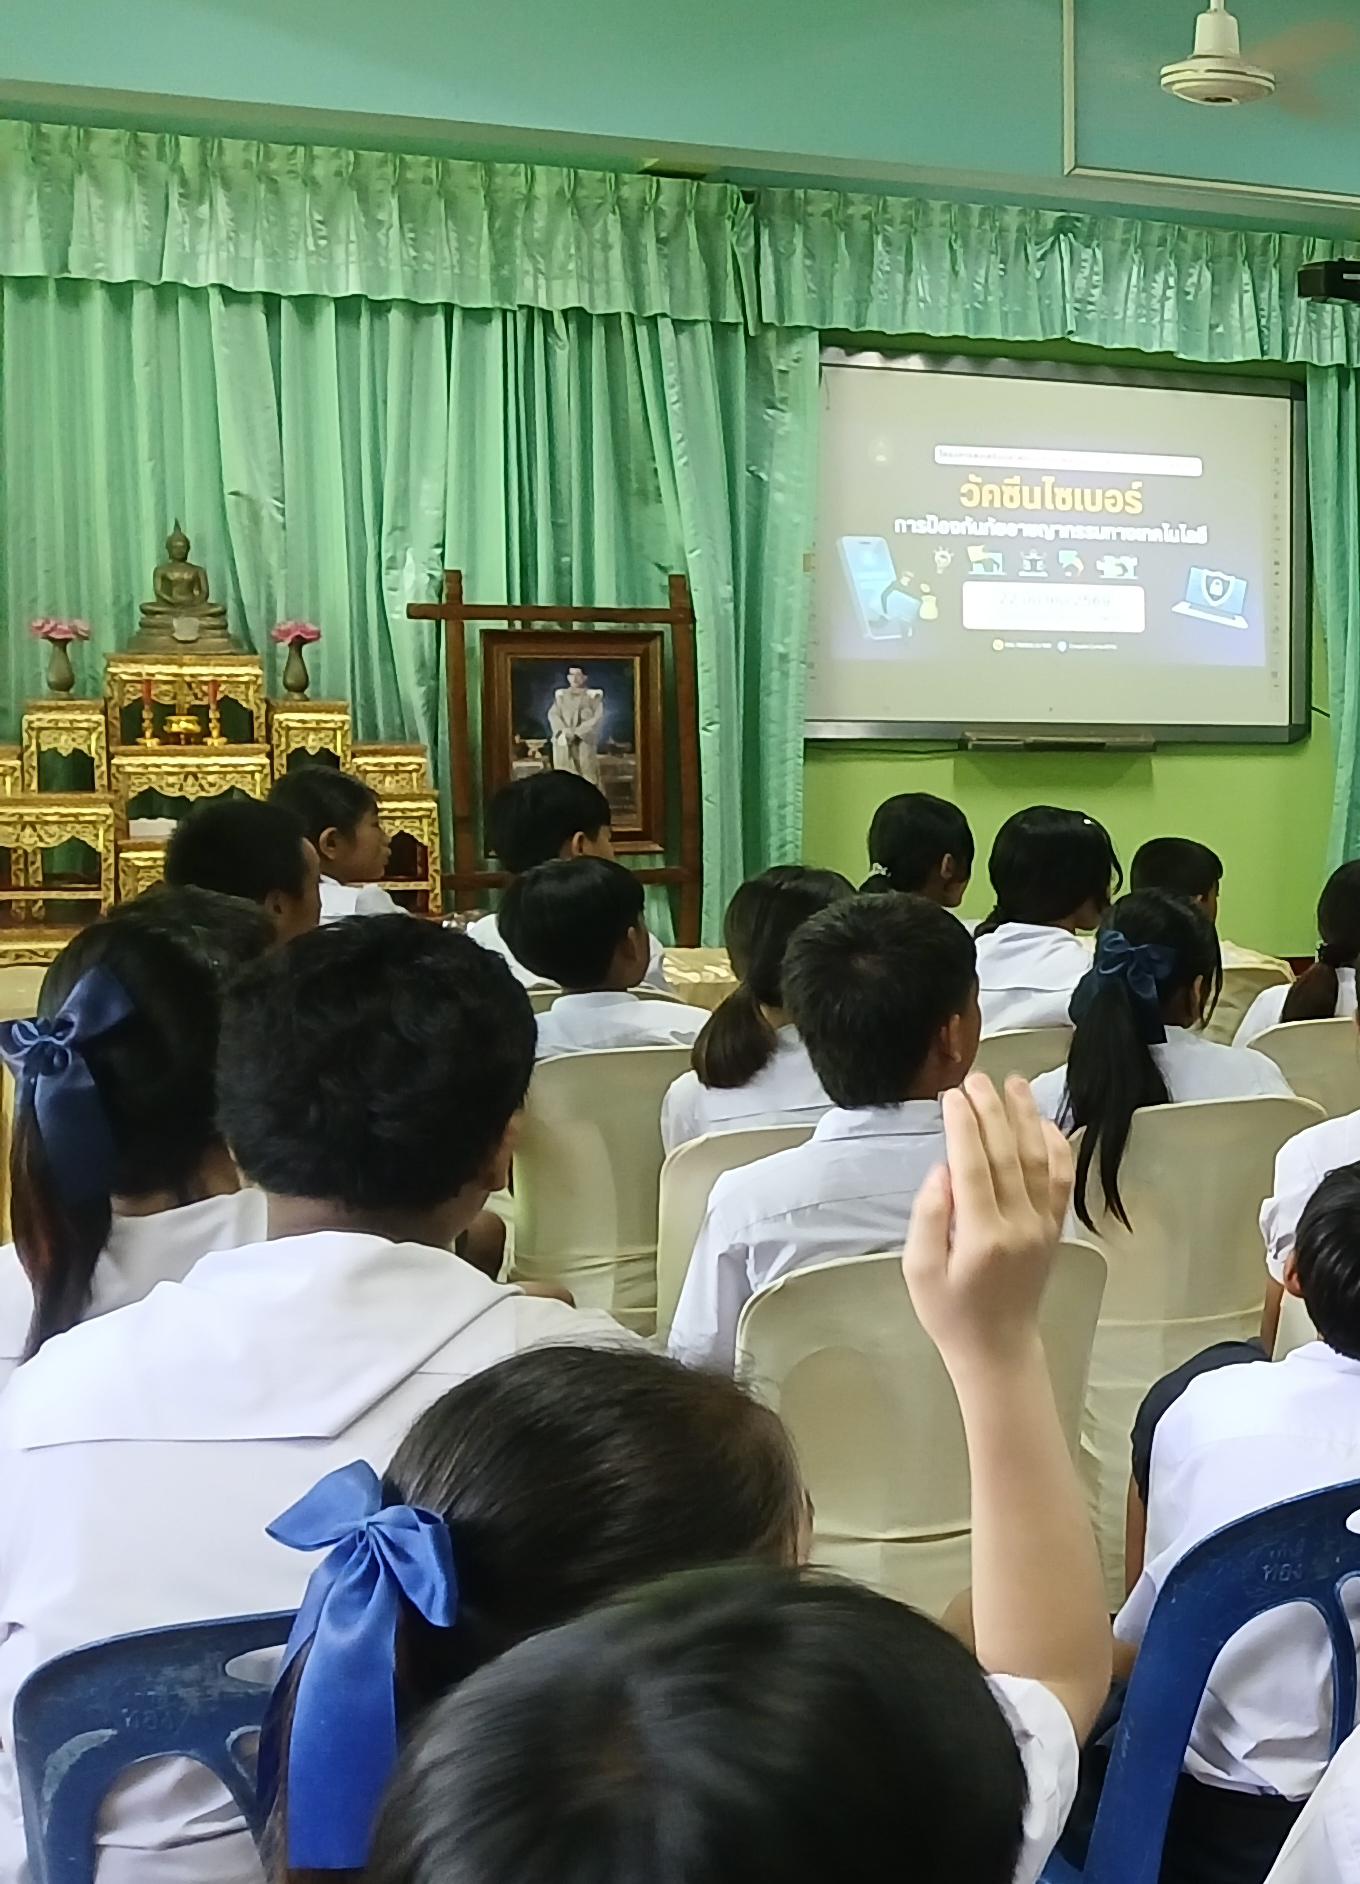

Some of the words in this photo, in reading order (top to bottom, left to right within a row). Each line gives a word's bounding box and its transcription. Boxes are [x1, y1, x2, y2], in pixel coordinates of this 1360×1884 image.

[959, 473, 1143, 515] วัคซีนไซเบอร์
